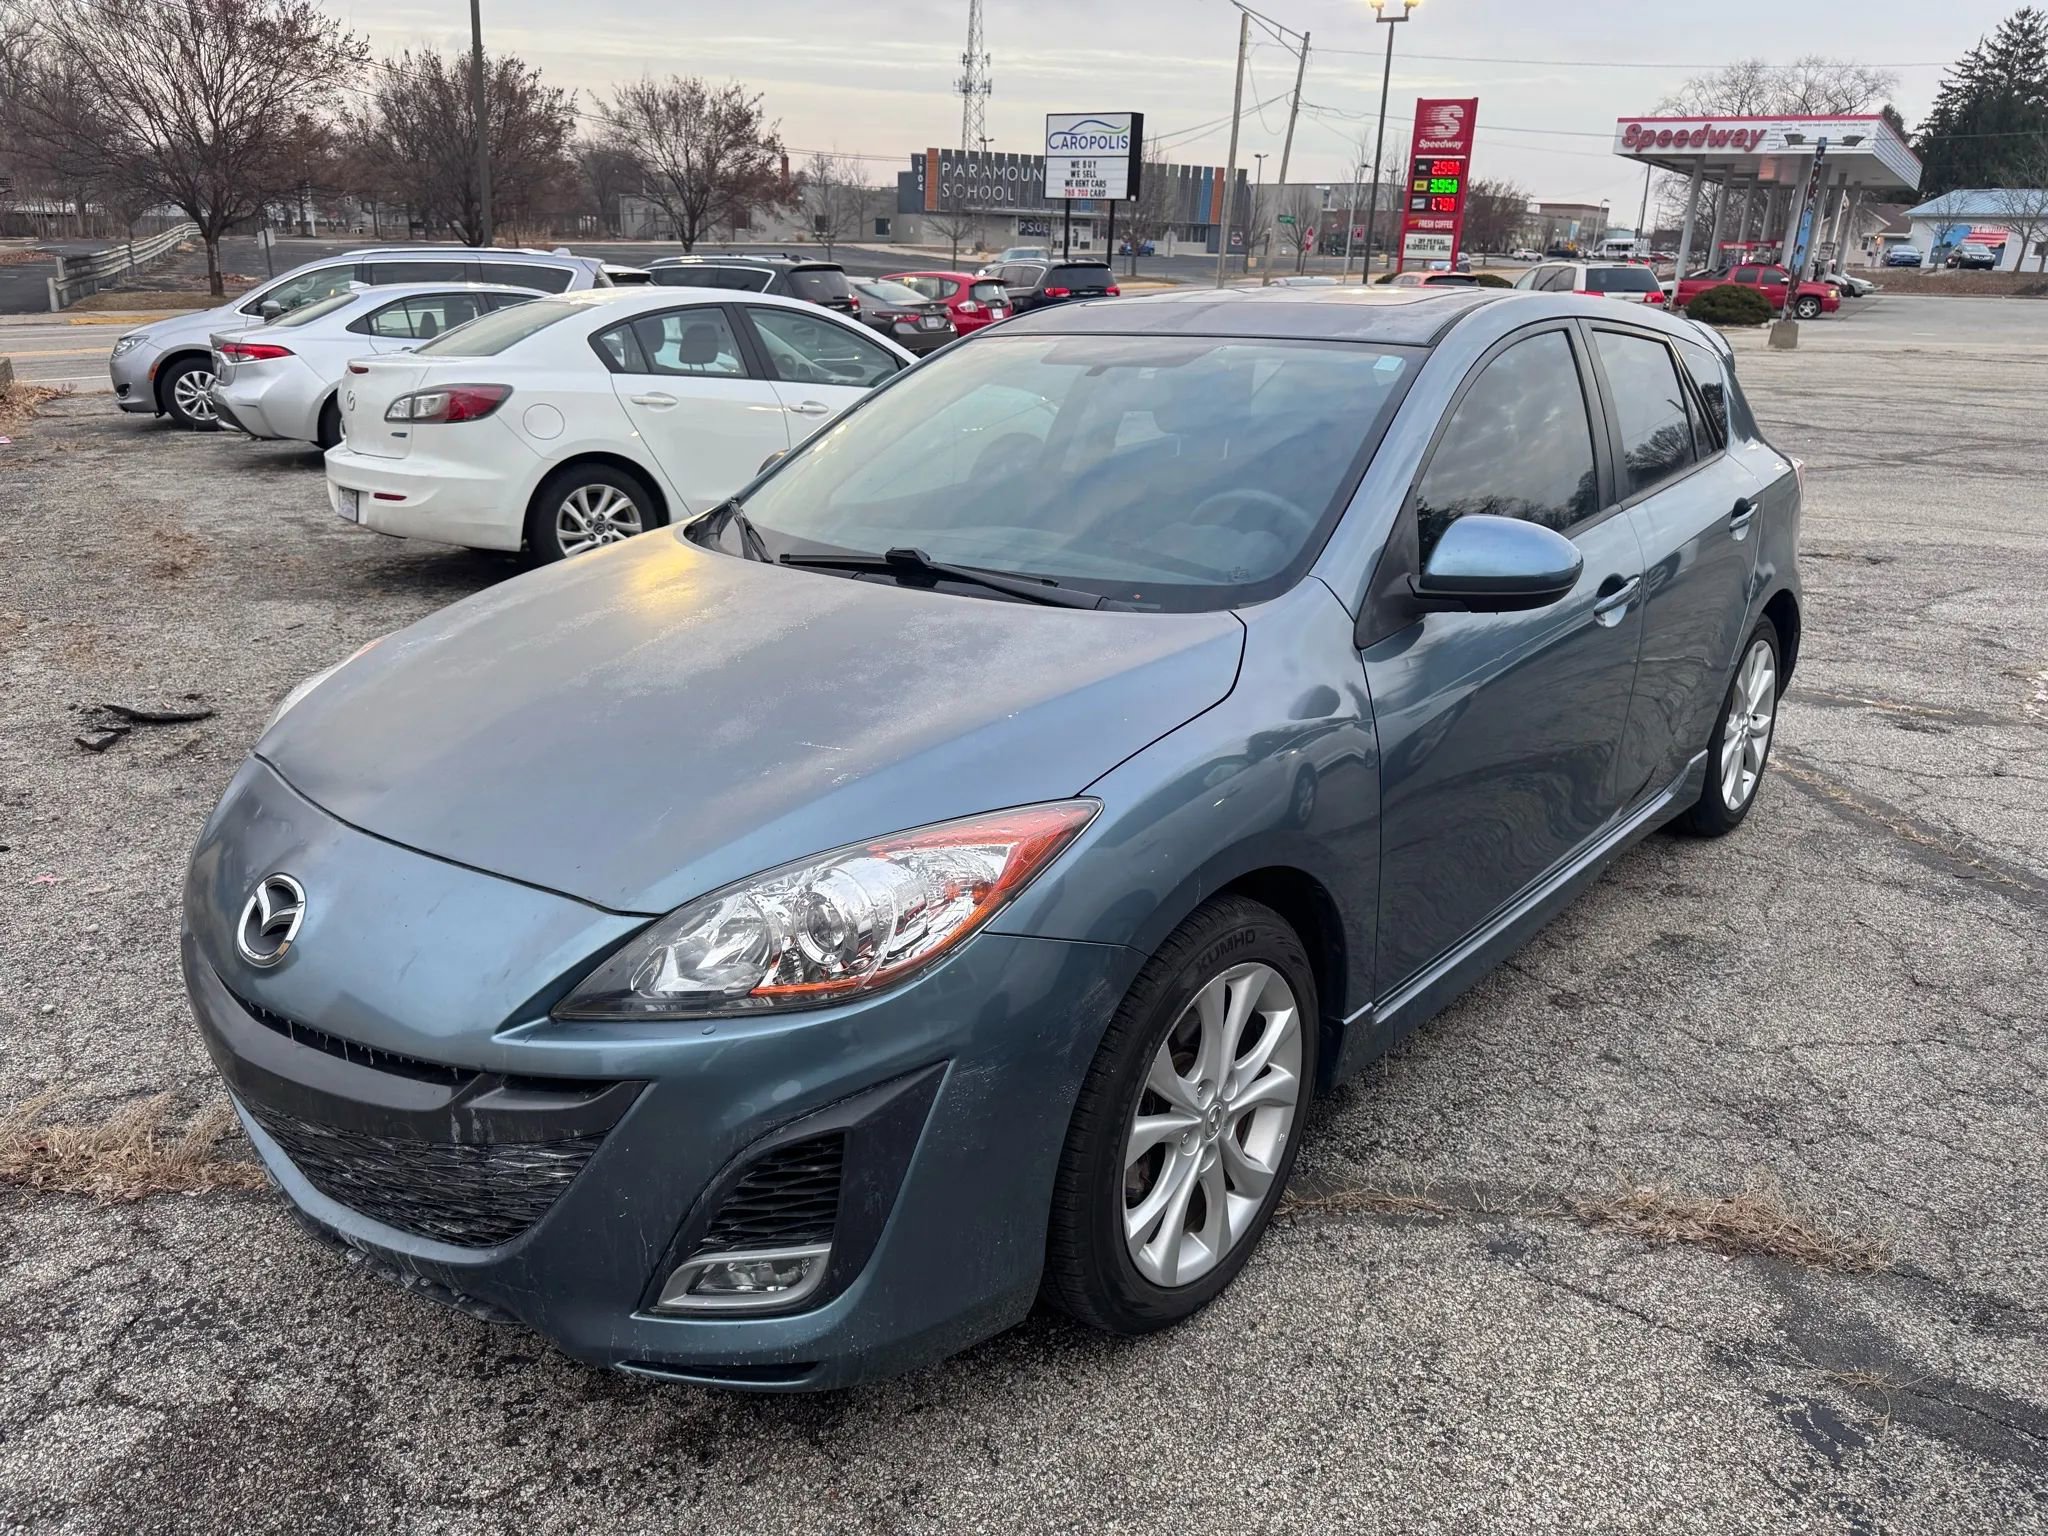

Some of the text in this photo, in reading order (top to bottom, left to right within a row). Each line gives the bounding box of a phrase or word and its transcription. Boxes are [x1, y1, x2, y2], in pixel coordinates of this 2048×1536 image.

[1048, 131, 1129, 150] CAROPOLIS
[1418, 139, 1464, 150] Speedway
[1621, 123, 1768, 153] Speedway
[941, 161, 1044, 182] PARAMOUN
[1070, 160, 1097, 169] WE BUY
[1070, 170, 1097, 178] WE SELL
[1064, 179, 1107, 188] WE RENT CARS
[941, 182, 1015, 201] SCHOOL
[1417, 219, 1435, 229] FRESH
[1434, 219, 1453, 229] COFFEE
[1198, 928, 1256, 975] KUMHO
